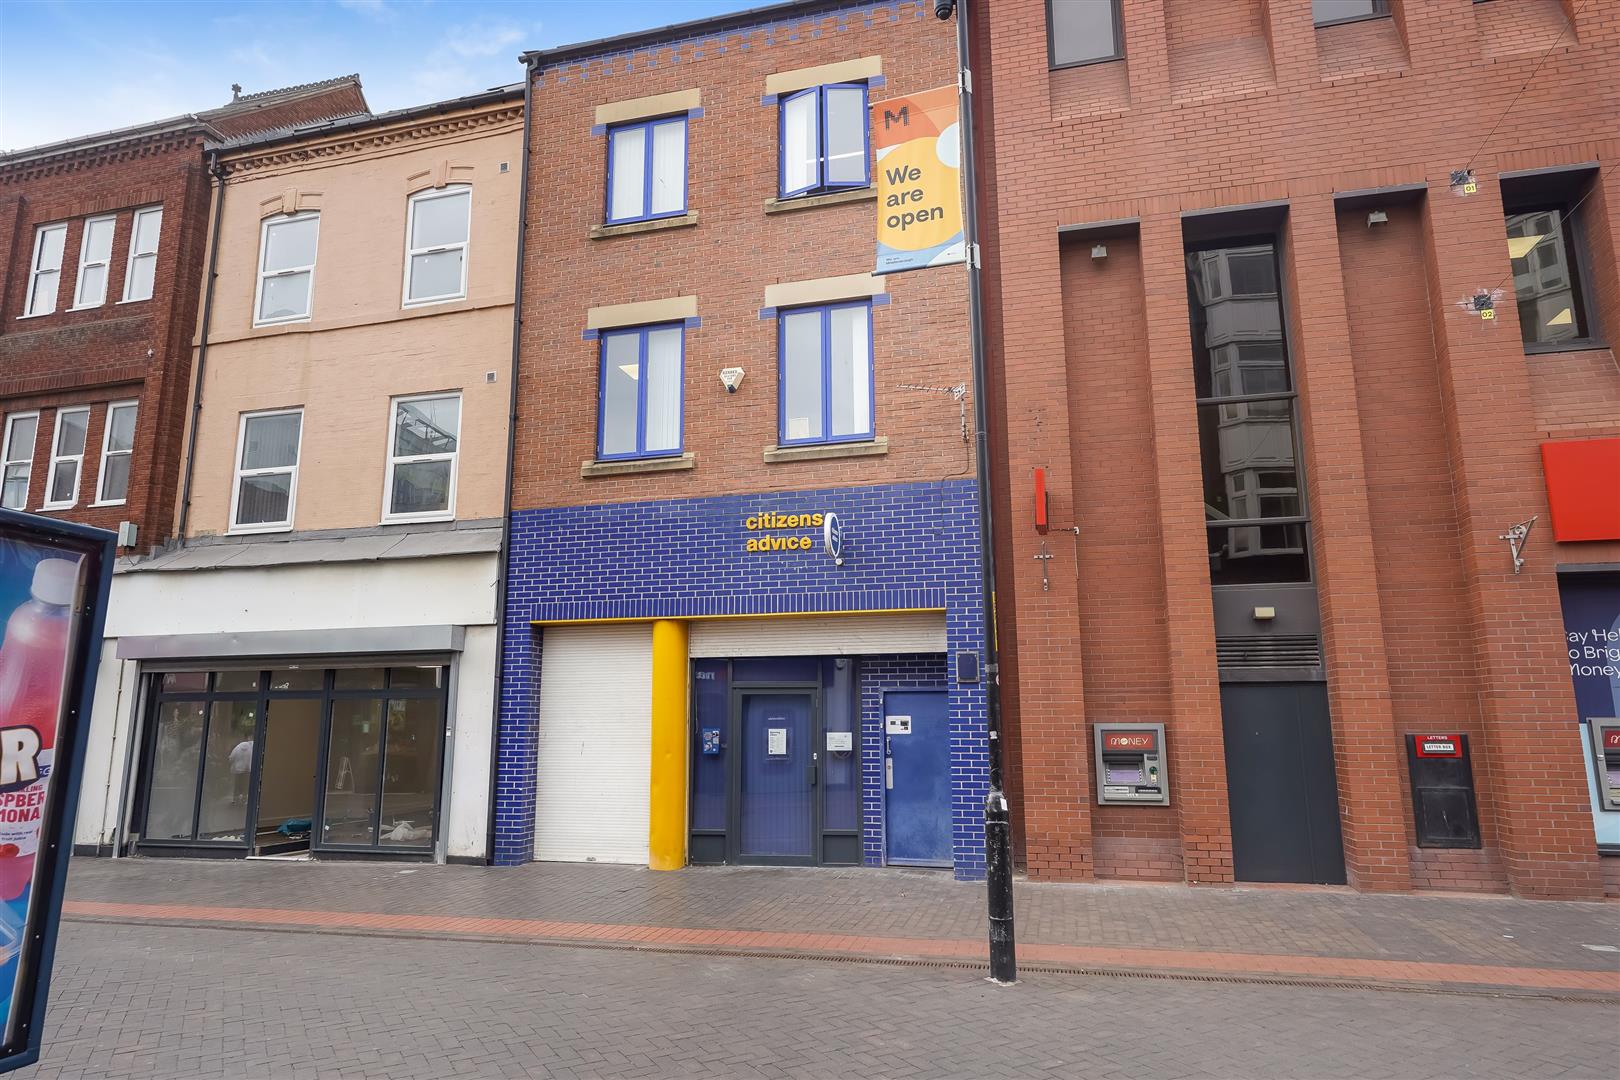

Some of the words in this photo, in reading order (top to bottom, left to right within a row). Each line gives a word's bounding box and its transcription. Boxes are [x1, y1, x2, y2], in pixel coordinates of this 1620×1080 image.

[884, 104, 910, 131] M
[886, 165, 922, 186] We
[886, 188, 924, 208] are
[886, 206, 944, 231] open
[745, 511, 824, 530] citizens
[746, 534, 812, 552] advice
[1566, 632, 1588, 645] ay
[1584, 646, 1620, 662] Brig
[1570, 663, 1620, 679] Money
[0, 728, 40, 787] R
